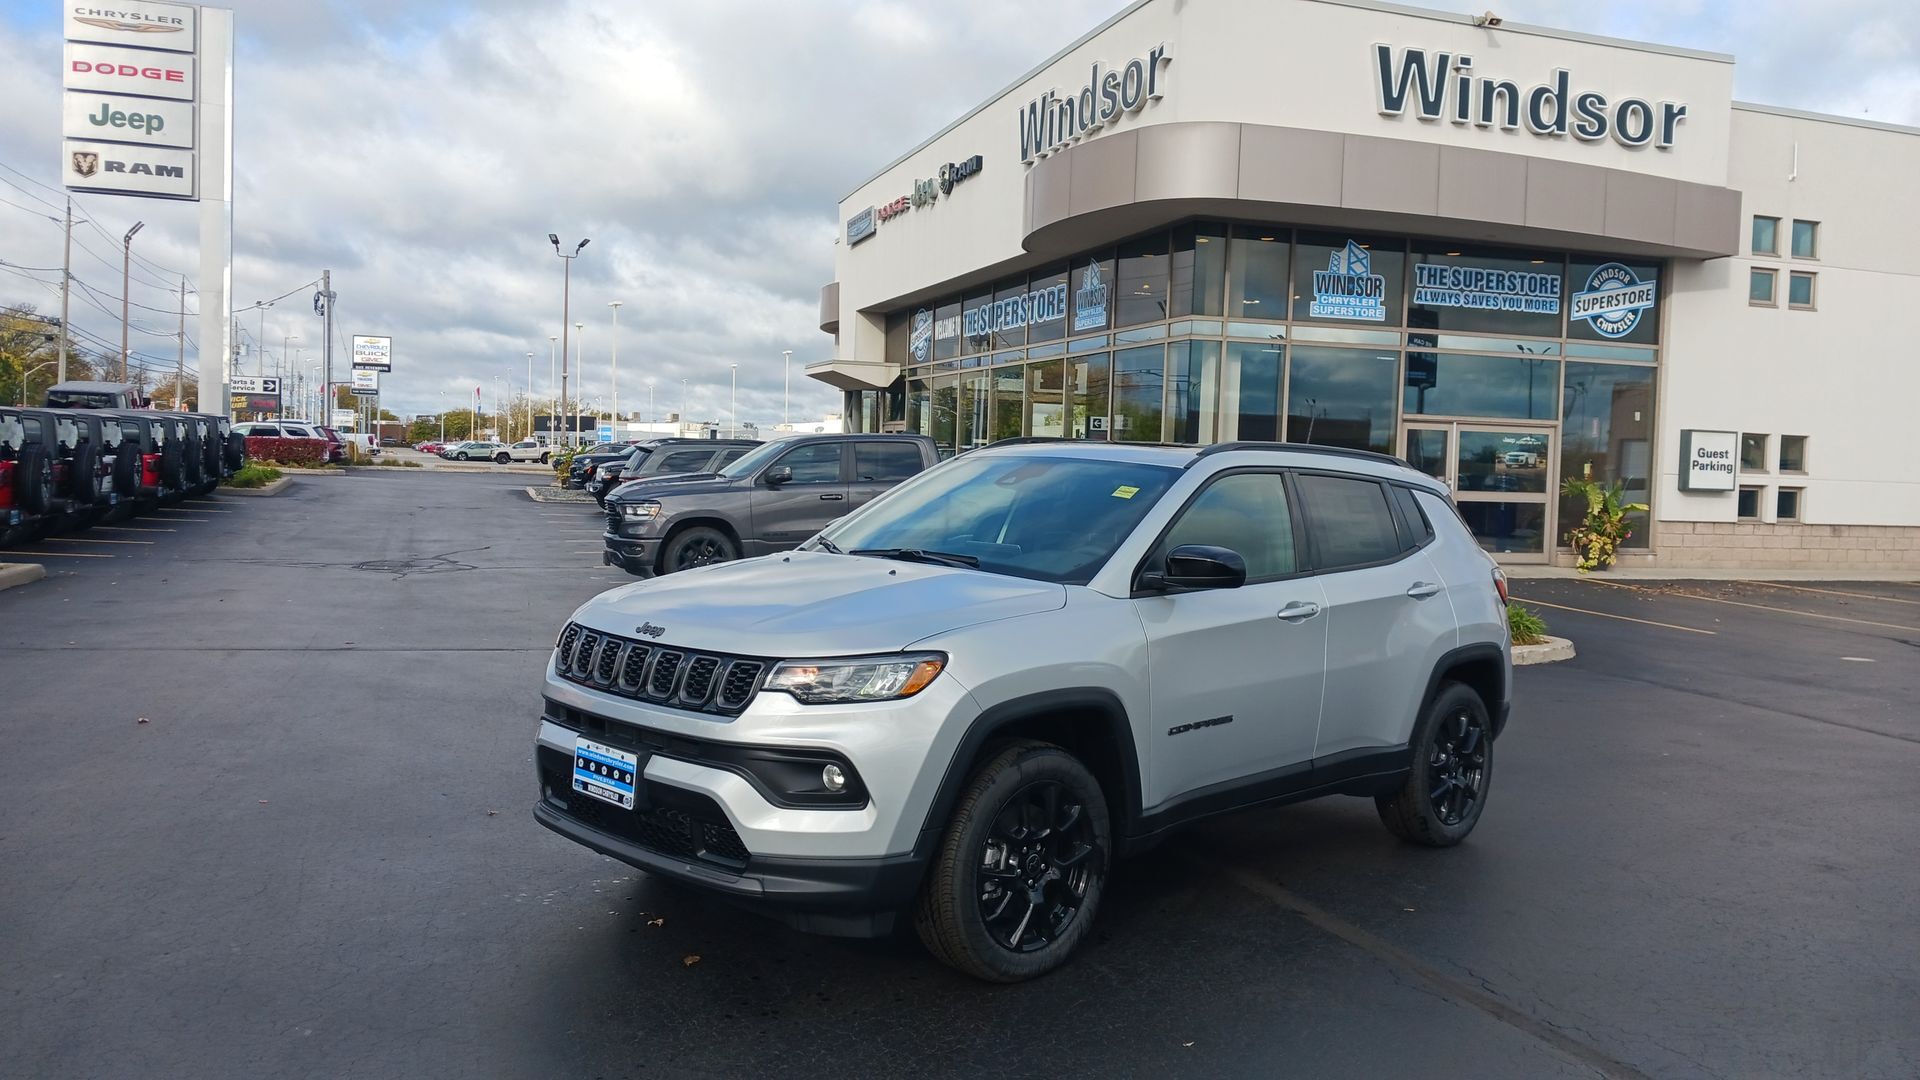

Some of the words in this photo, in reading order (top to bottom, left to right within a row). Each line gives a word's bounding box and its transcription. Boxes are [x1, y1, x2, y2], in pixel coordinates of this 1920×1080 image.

[75, 8, 183, 25] CHRYSLER
[72, 60, 184, 83] DODGE
[1018, 40, 1172, 164] Windsor
[1372, 42, 1688, 149] Windsor
[89, 103, 164, 135] Jeep
[104, 160, 184, 179] RAM
[950, 155, 983, 182] RAM
[911, 178, 939, 206] Jeep
[1315, 273, 1383, 298] WINDSOR
[1416, 266, 1448, 287] THE
[1451, 268, 1559, 295] SUPERSTORE
[1592, 268, 1631, 288] WINDSOR
[963, 311, 977, 336] THE
[980, 286, 1066, 335] SUPERSTORE
[1313, 305, 1383, 317] SUPERSTORE
[1321, 295, 1376, 306] CHRYSLER
[1416, 290, 1460, 305] ALWAYS
[1463, 292, 1499, 308] SAVES
[1501, 296, 1521, 310] YOU
[1523, 298, 1558, 312] MORE!
[1575, 288, 1652, 313] SUPERSTORE
[1596, 311, 1636, 333] CHRYSLER
[1697, 447, 1729, 459] Guest
[1692, 460, 1733, 474] Parking
[635, 621, 666, 639] Jeep
